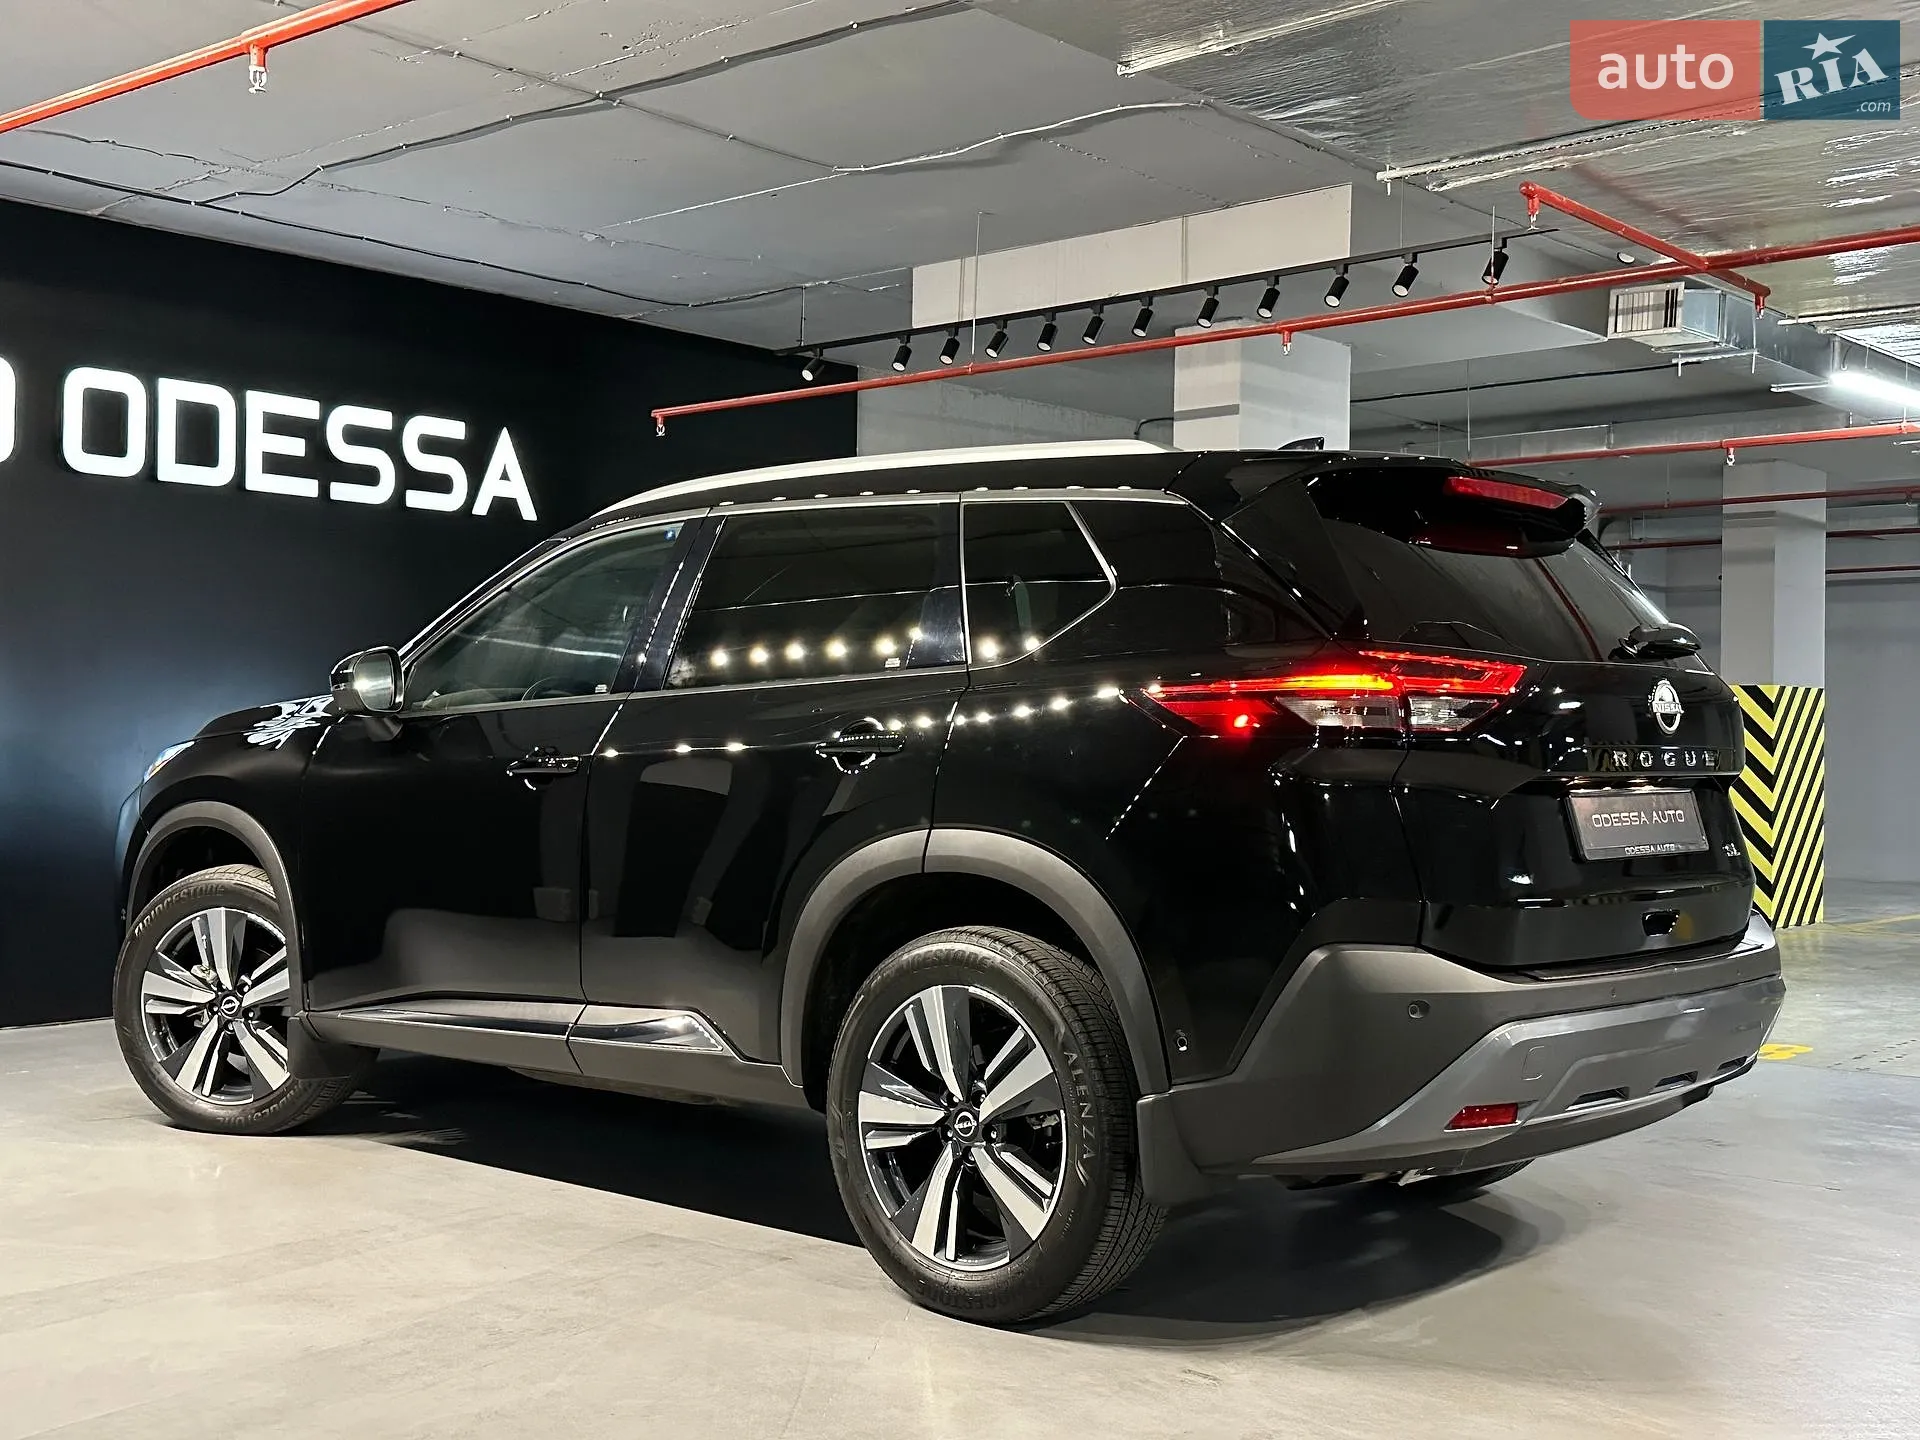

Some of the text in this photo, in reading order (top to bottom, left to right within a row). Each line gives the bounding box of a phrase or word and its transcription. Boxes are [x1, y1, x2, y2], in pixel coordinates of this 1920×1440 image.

[61, 366, 538, 521] ODESSA
[1613, 750, 1715, 767] ROGUE
[1592, 810, 1685, 828] ODESSA AUTO
[1624, 843, 1676, 856] ODESSA AUTO
[1063, 1051, 1096, 1160] ALENZA
